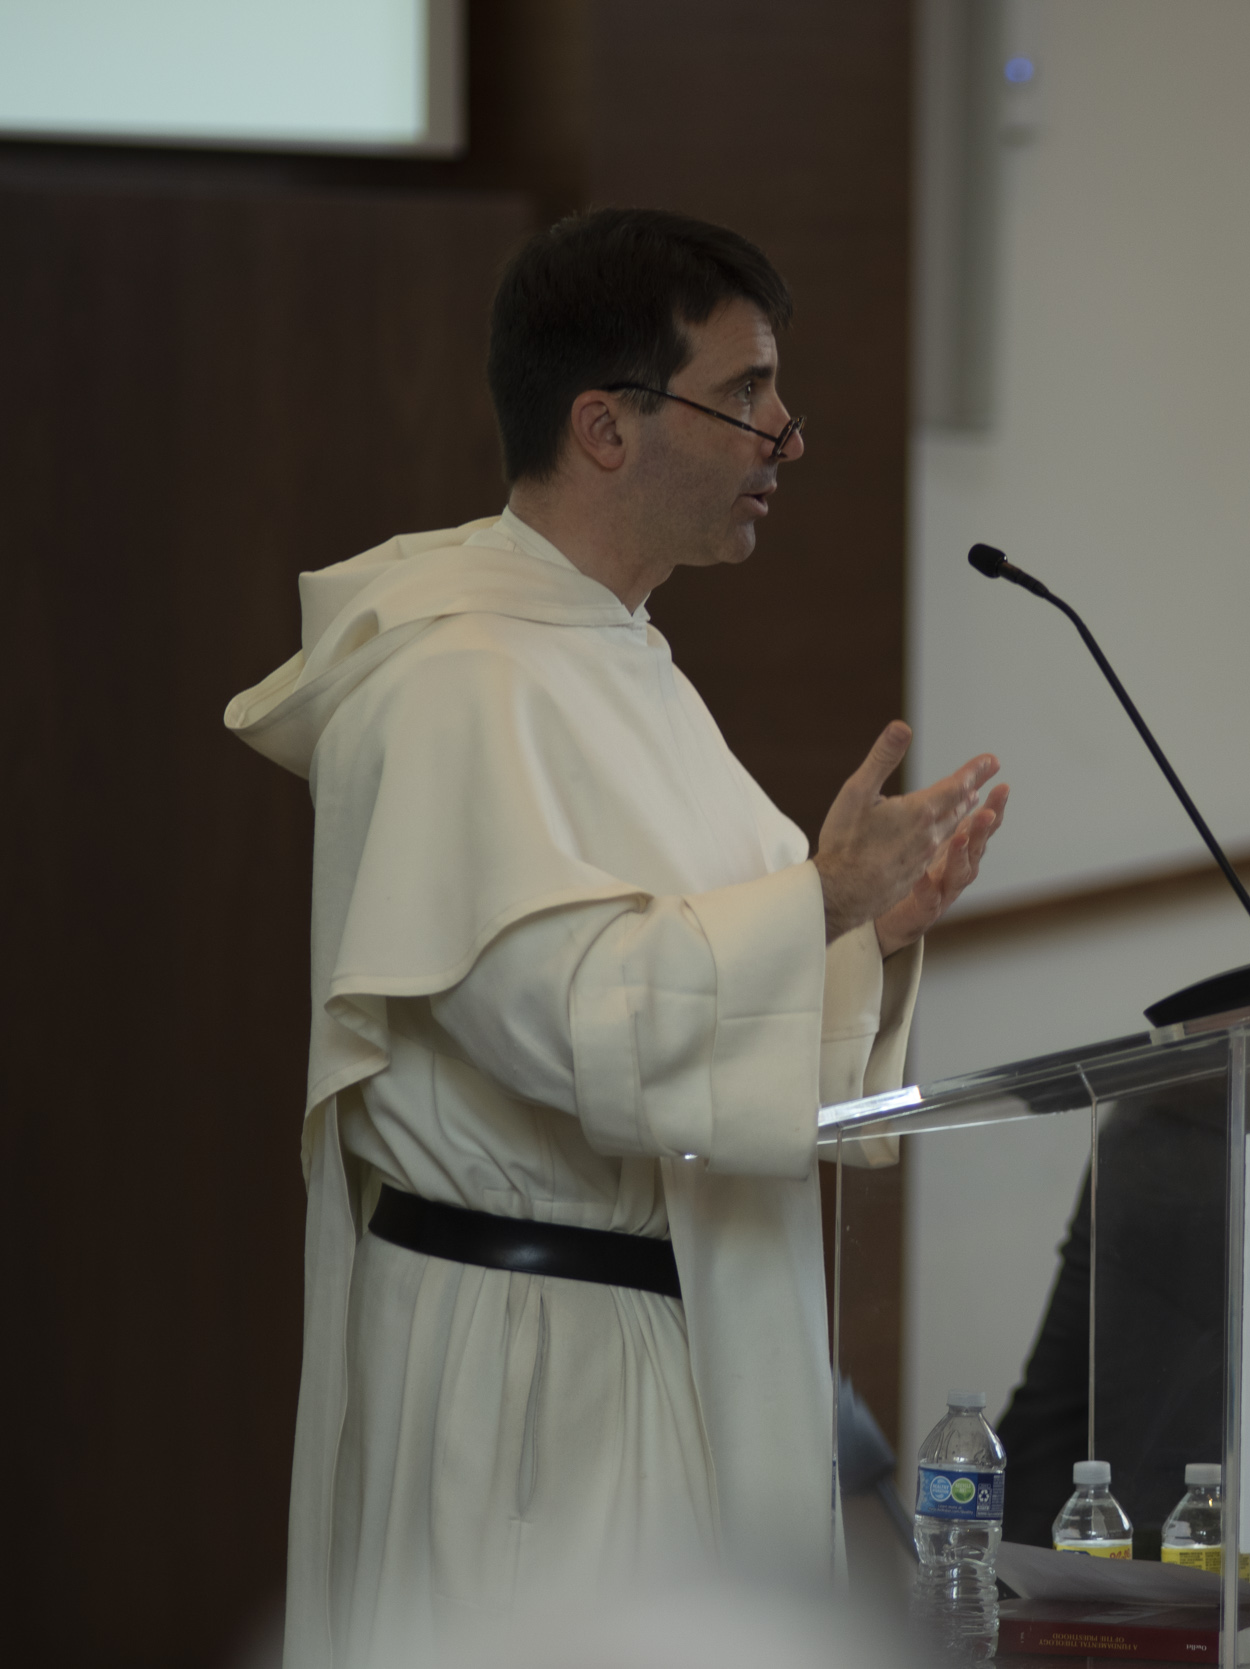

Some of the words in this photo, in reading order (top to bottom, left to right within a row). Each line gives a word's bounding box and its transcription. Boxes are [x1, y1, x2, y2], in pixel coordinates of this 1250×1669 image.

[1052, 1633, 1098, 1642] PRIESTHOOD
[1039, 1639, 1078, 1647] THEOLOGY
[1080, 1641, 1131, 1650] FUNDAMENTAL
[1186, 1643, 1207, 1651] Ouellet
